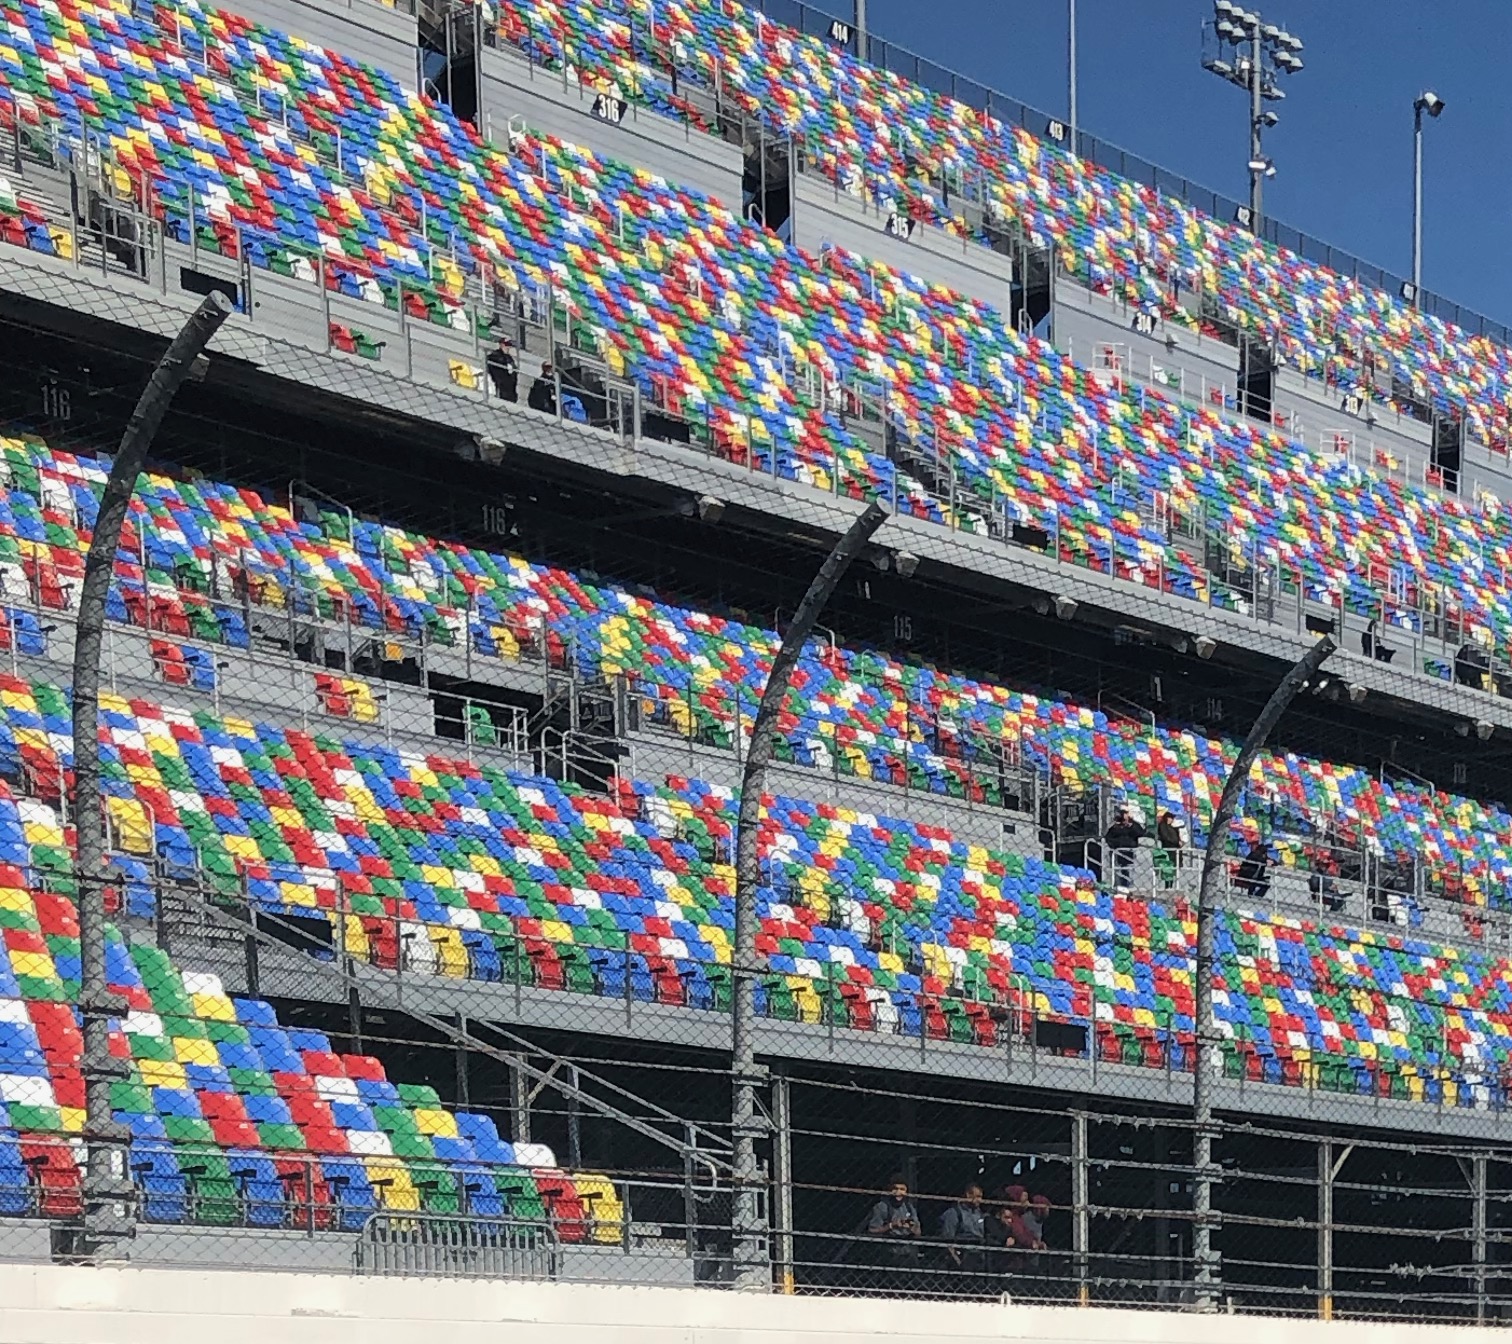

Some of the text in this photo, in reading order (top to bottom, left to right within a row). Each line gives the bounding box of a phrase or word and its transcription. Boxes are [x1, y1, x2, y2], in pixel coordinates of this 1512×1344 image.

[832, 21, 848, 43] 414
[598, 94, 619, 122] 316
[891, 213, 909, 239] 315
[1136, 312, 1152, 334] 314
[41, 384, 71, 420] 116
[481, 504, 506, 535] 116
[893, 615, 912, 641] 115
